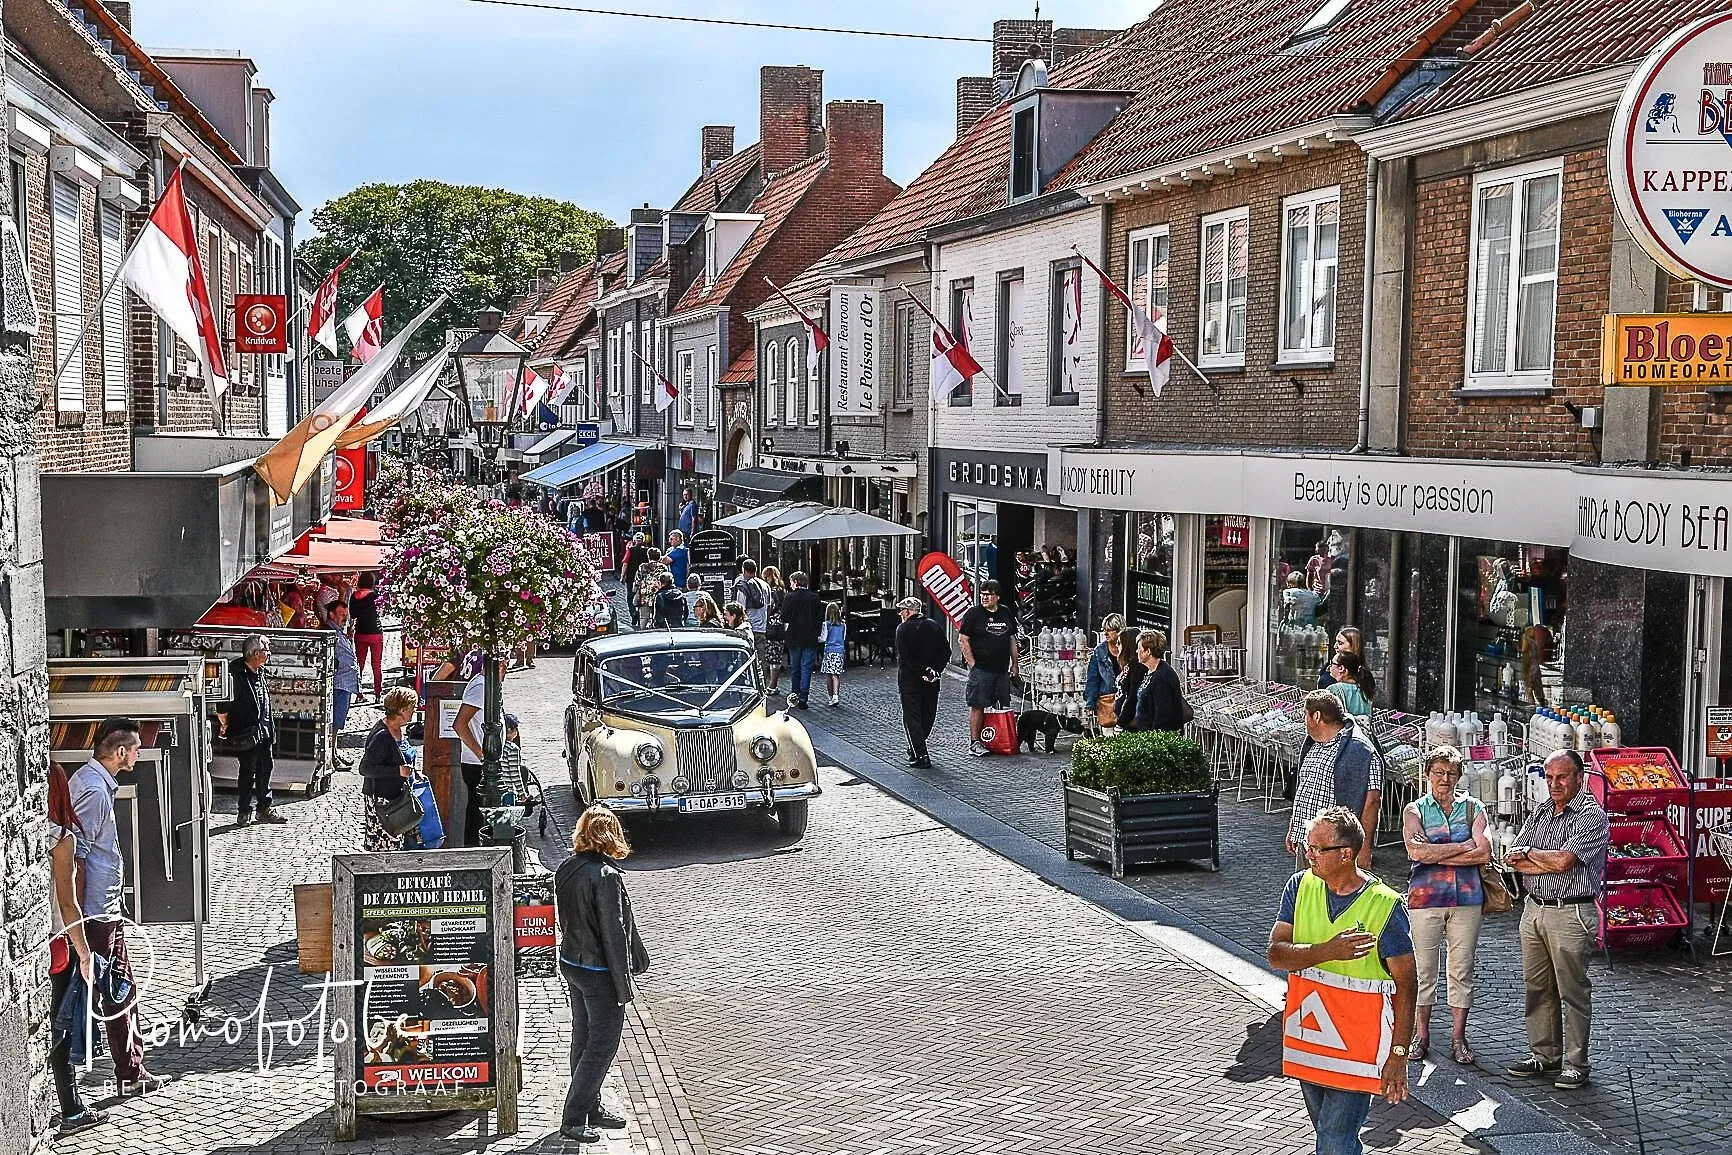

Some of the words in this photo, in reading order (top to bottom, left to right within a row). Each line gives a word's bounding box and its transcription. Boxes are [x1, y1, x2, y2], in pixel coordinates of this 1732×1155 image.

[1643, 170, 1732, 191] KAPPE
[1668, 209, 1703, 218] Biohorma
[838, 292, 849, 342] Tearoom
[860, 294, 873, 328] d'Or
[245, 337, 277, 345] Kruidvat
[860, 332, 873, 390] Poisson
[838, 345, 849, 411] Restaurant
[1623, 364, 1732, 379] HOMEOPAT
[315, 378, 339, 387] uhse
[860, 391, 873, 411] Le
[949, 462, 1045, 491] GROOSMA
[1090, 469, 1135, 496] BEAUTY
[1295, 472, 1352, 510] Beauty
[1357, 475, 1371, 506] is
[1376, 483, 1407, 509] our
[1413, 483, 1494, 515] passion
[1579, 496, 1596, 538] HAIR
[1614, 502, 1671, 548] BODY
[1682, 506, 1729, 552] BEA
[592, 548, 609, 558] SALE
[686, 797, 744, 810] 1-OAP-515
[397, 873, 451, 889] EETCAFÉ
[363, 893, 380, 905] DE
[384, 890, 439, 904] ZEVENDE
[443, 889, 487, 902] HEMEL
[388, 907, 429, 915] GEZELLIGHEID
[440, 906, 463, 914] LEKKER
[522, 918, 547, 927] TUIN
[516, 927, 554, 937] TERRAS
[408, 1067, 478, 1080] WELKOM
